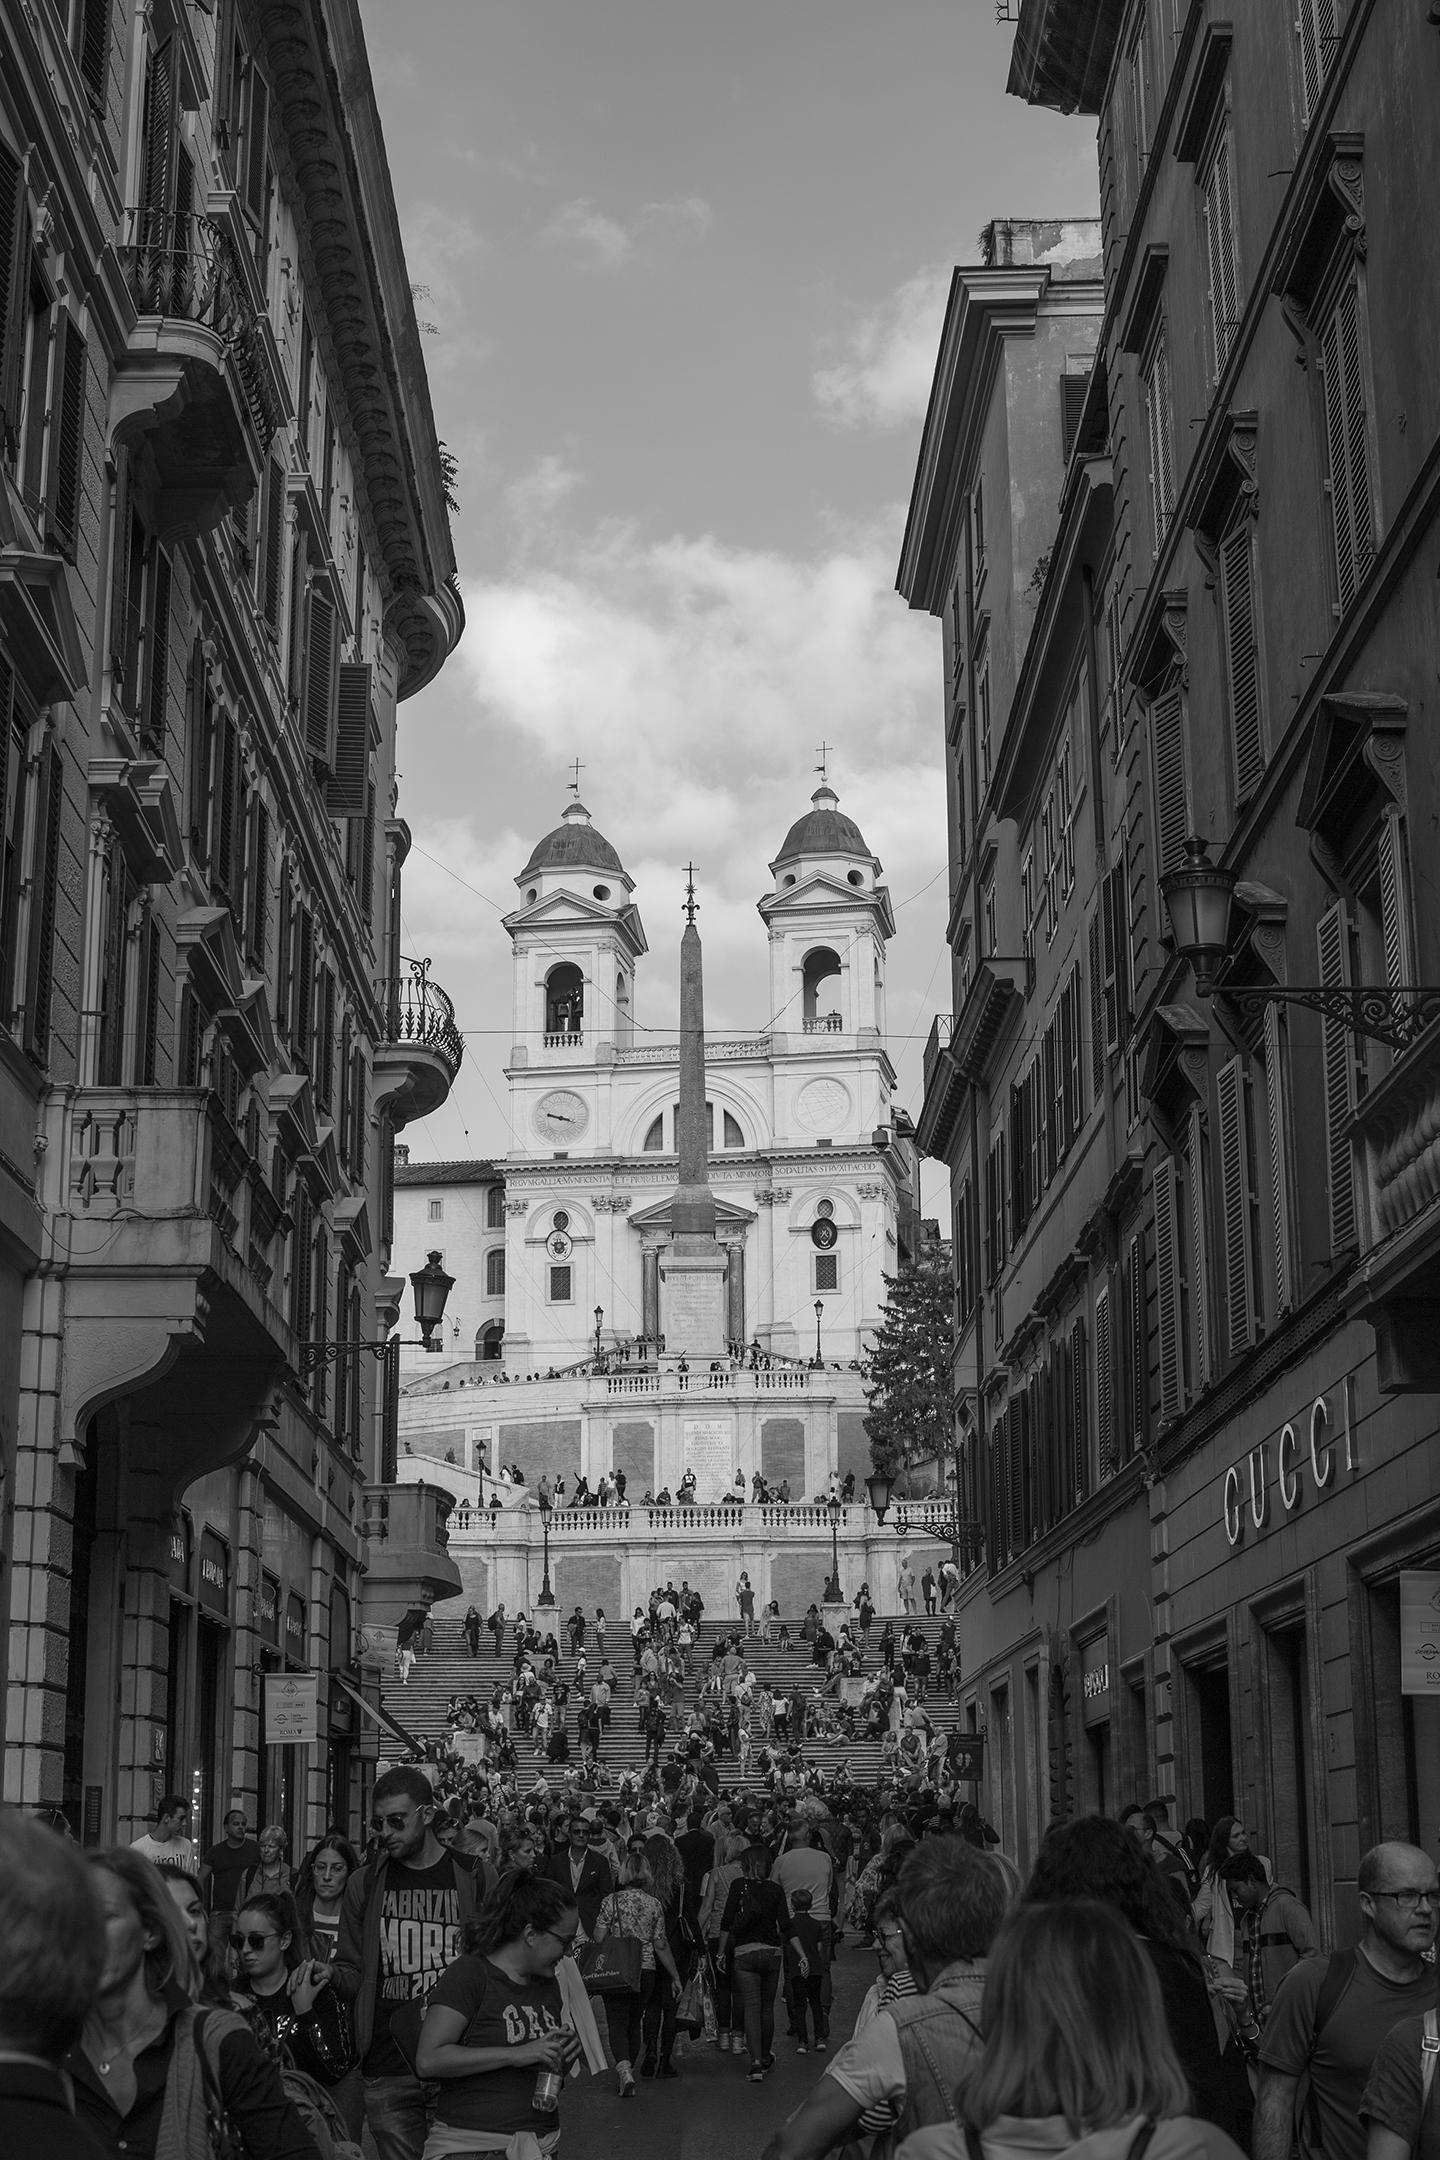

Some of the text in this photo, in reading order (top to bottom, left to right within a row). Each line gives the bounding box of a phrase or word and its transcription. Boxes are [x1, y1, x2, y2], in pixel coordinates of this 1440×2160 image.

[651, 1173, 679, 1183] ELEMO
[1223, 1374, 1360, 1546] GUCCI
[171, 1536, 185, 1563] ADA
[1426, 1671, 1440, 1680] RO
[379, 1916, 462, 1977] MORO
[381, 1974, 409, 2001] TOUR
